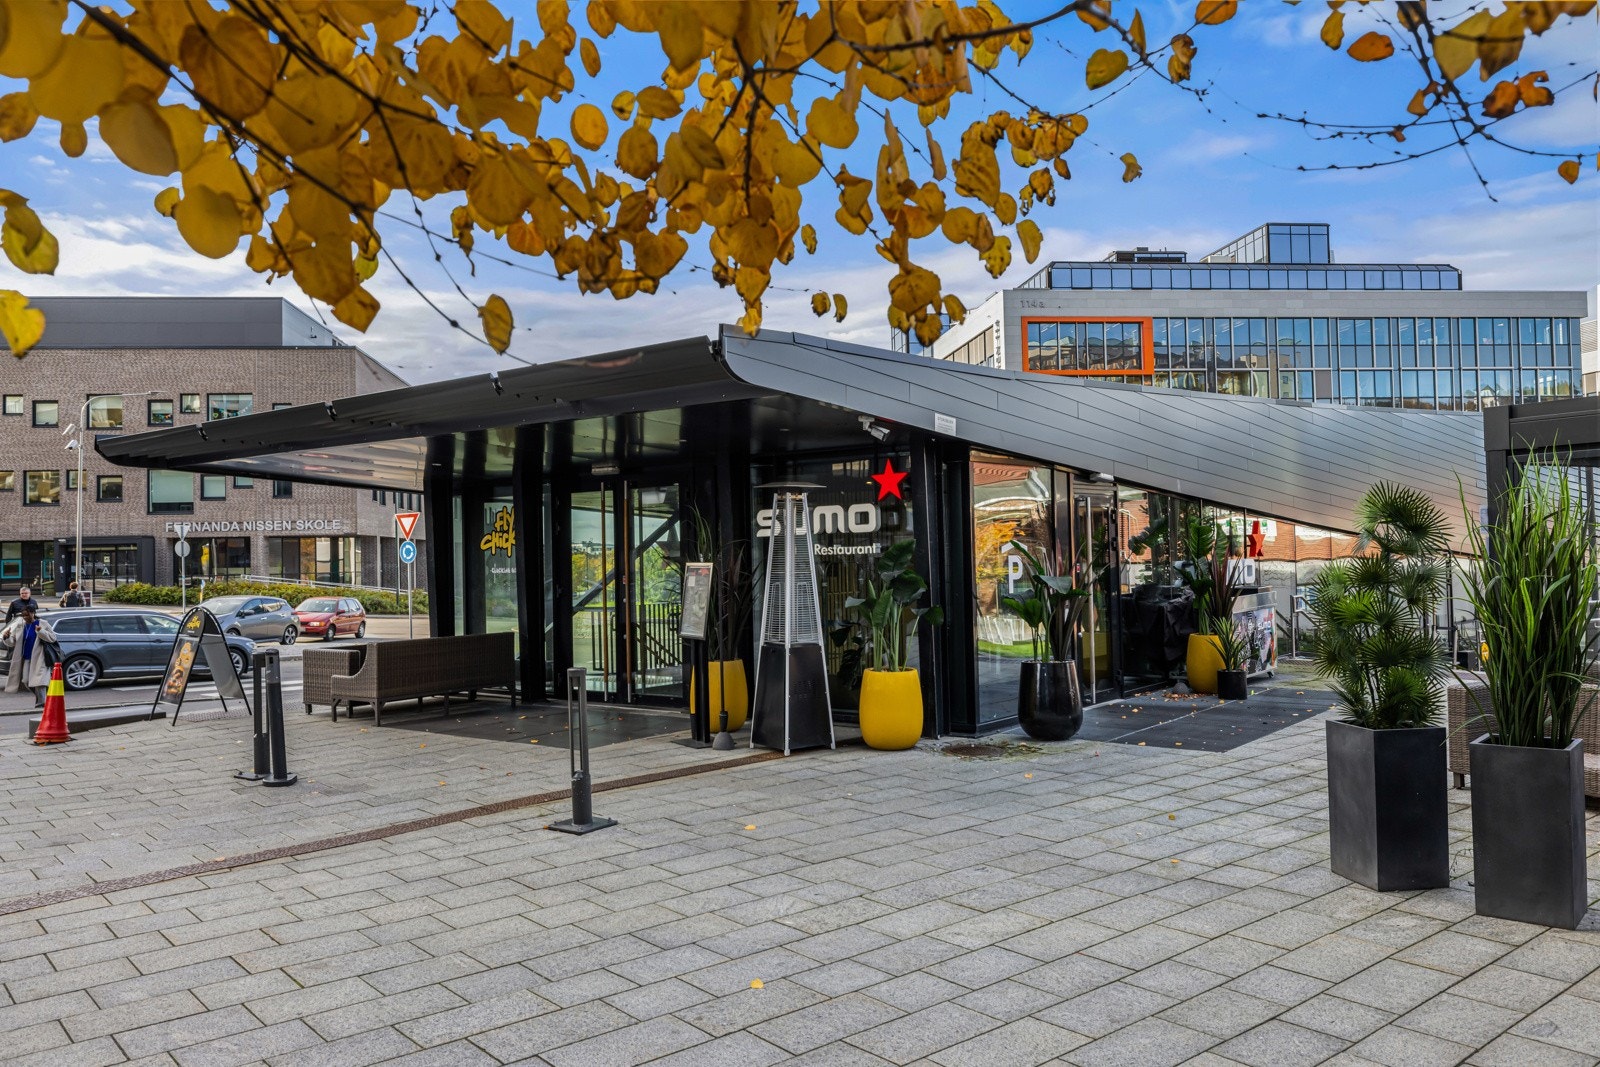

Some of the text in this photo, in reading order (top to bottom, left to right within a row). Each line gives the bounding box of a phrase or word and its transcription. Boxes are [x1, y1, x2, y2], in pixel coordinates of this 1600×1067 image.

[243, 520, 292, 531] NISSEN
[295, 519, 341, 531] SKOLE
[814, 543, 877, 556] Restaurant
[1008, 555, 1023, 594] P
